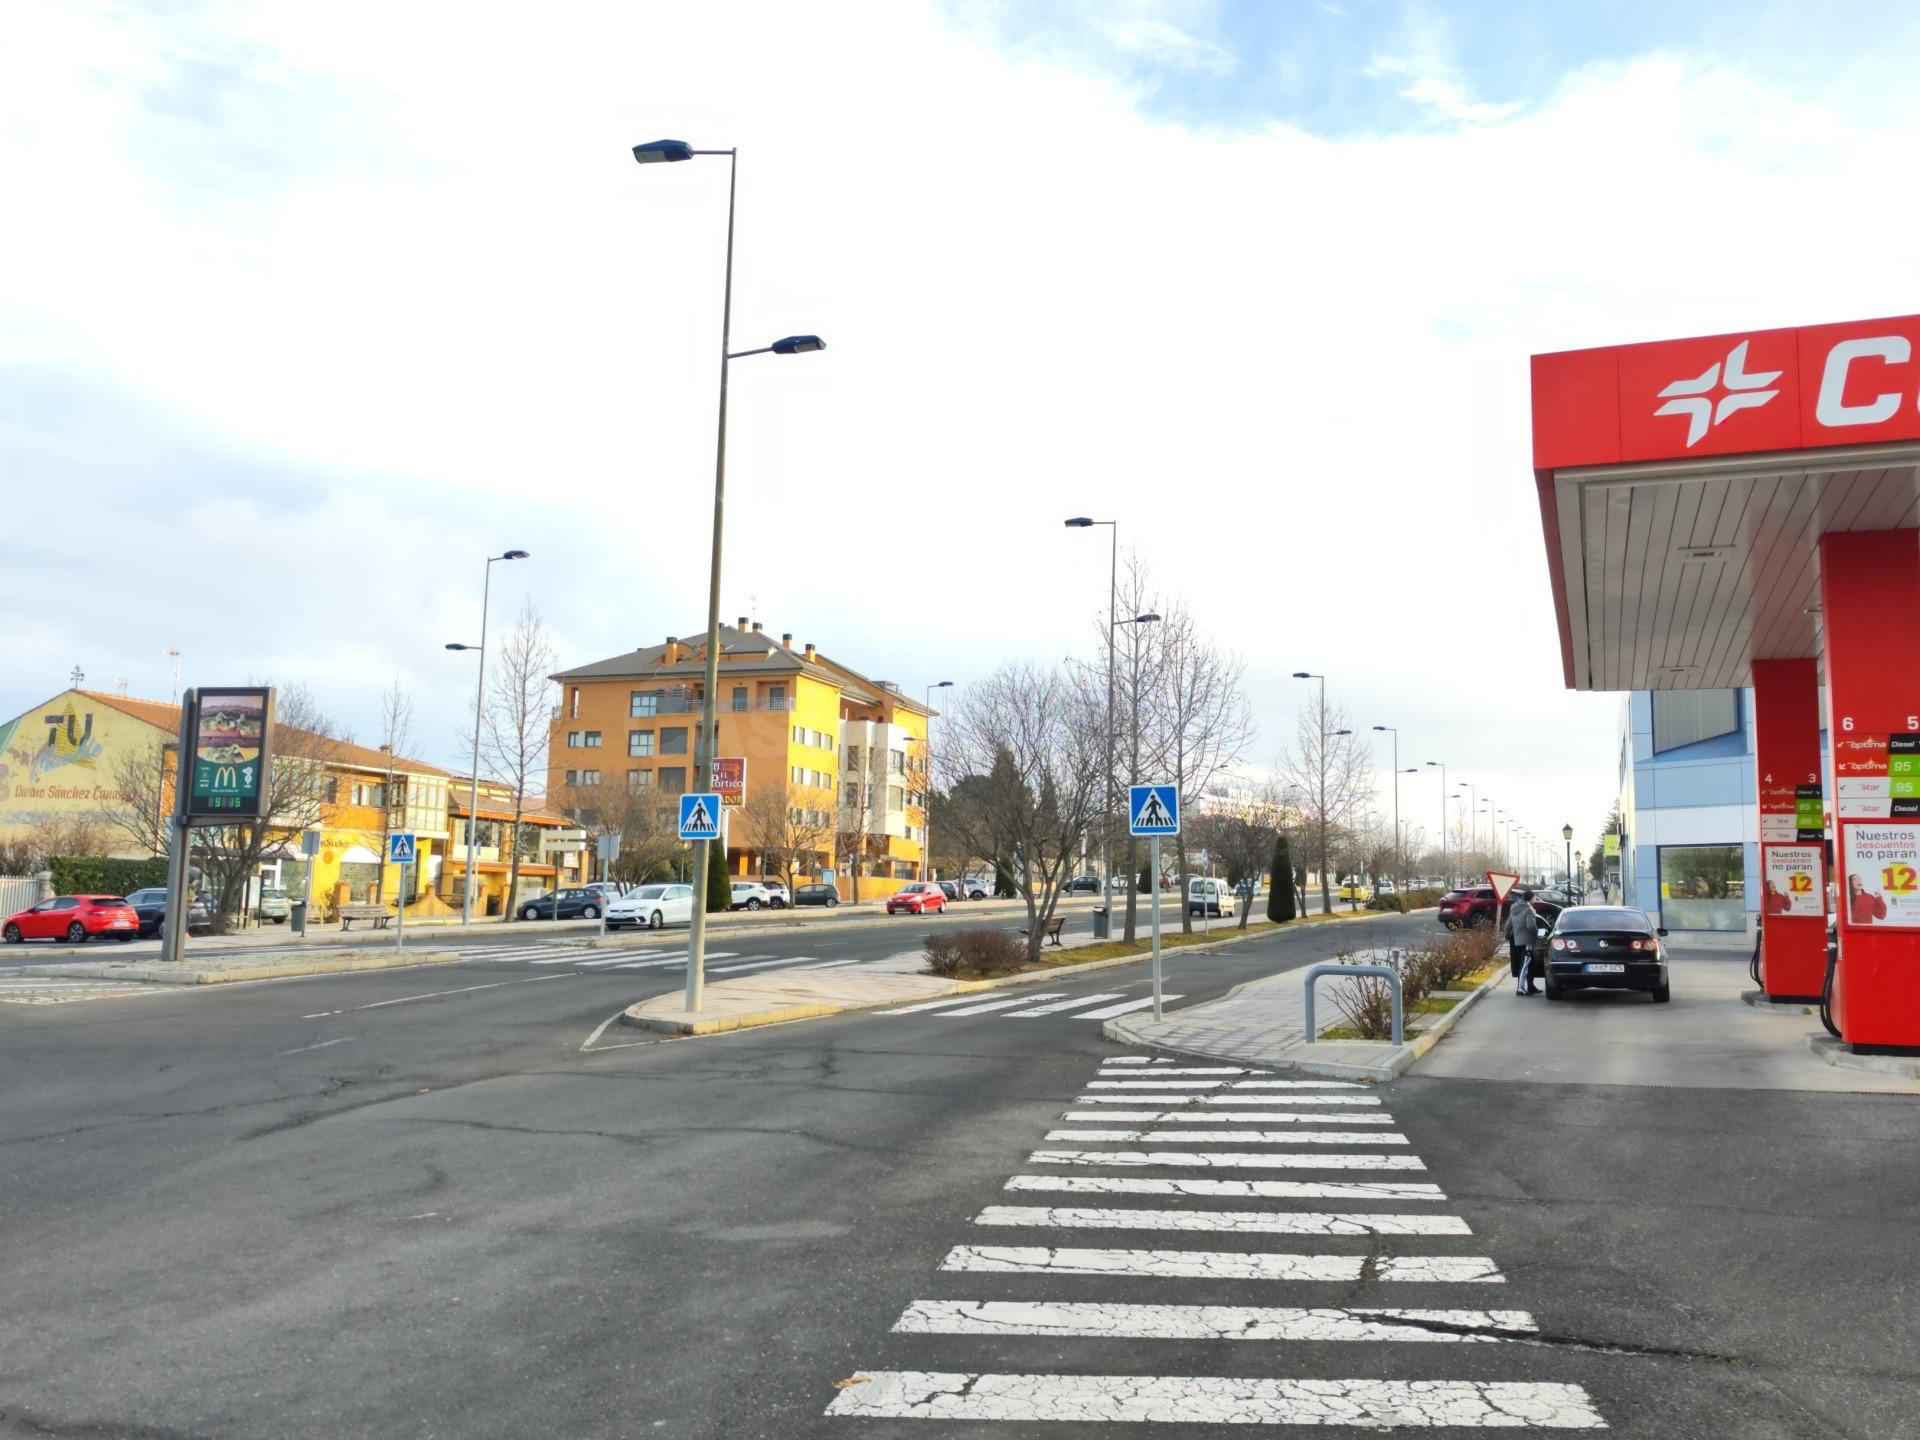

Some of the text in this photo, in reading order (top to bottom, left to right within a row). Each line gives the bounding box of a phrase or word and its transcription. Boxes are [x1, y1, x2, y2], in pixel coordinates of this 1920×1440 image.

[1815, 335, 1920, 427] C
[1842, 717, 1854, 731] 6
[1907, 716, 1919, 730] 5
[1891, 740, 1915, 748] Diesel
[1894, 761, 1912, 771] 95
[1764, 773, 1773, 784] 4
[1808, 773, 1817, 783] 3
[1895, 782, 1913, 792] 95
[1855, 830, 1915, 841] Nuestros
[1855, 841, 1916, 849] descuentos
[1856, 850, 1917, 861] no paran
[1786, 864, 1813, 872] paran
[1788, 875, 1813, 892] 12
[1882, 867, 1918, 891] 12
